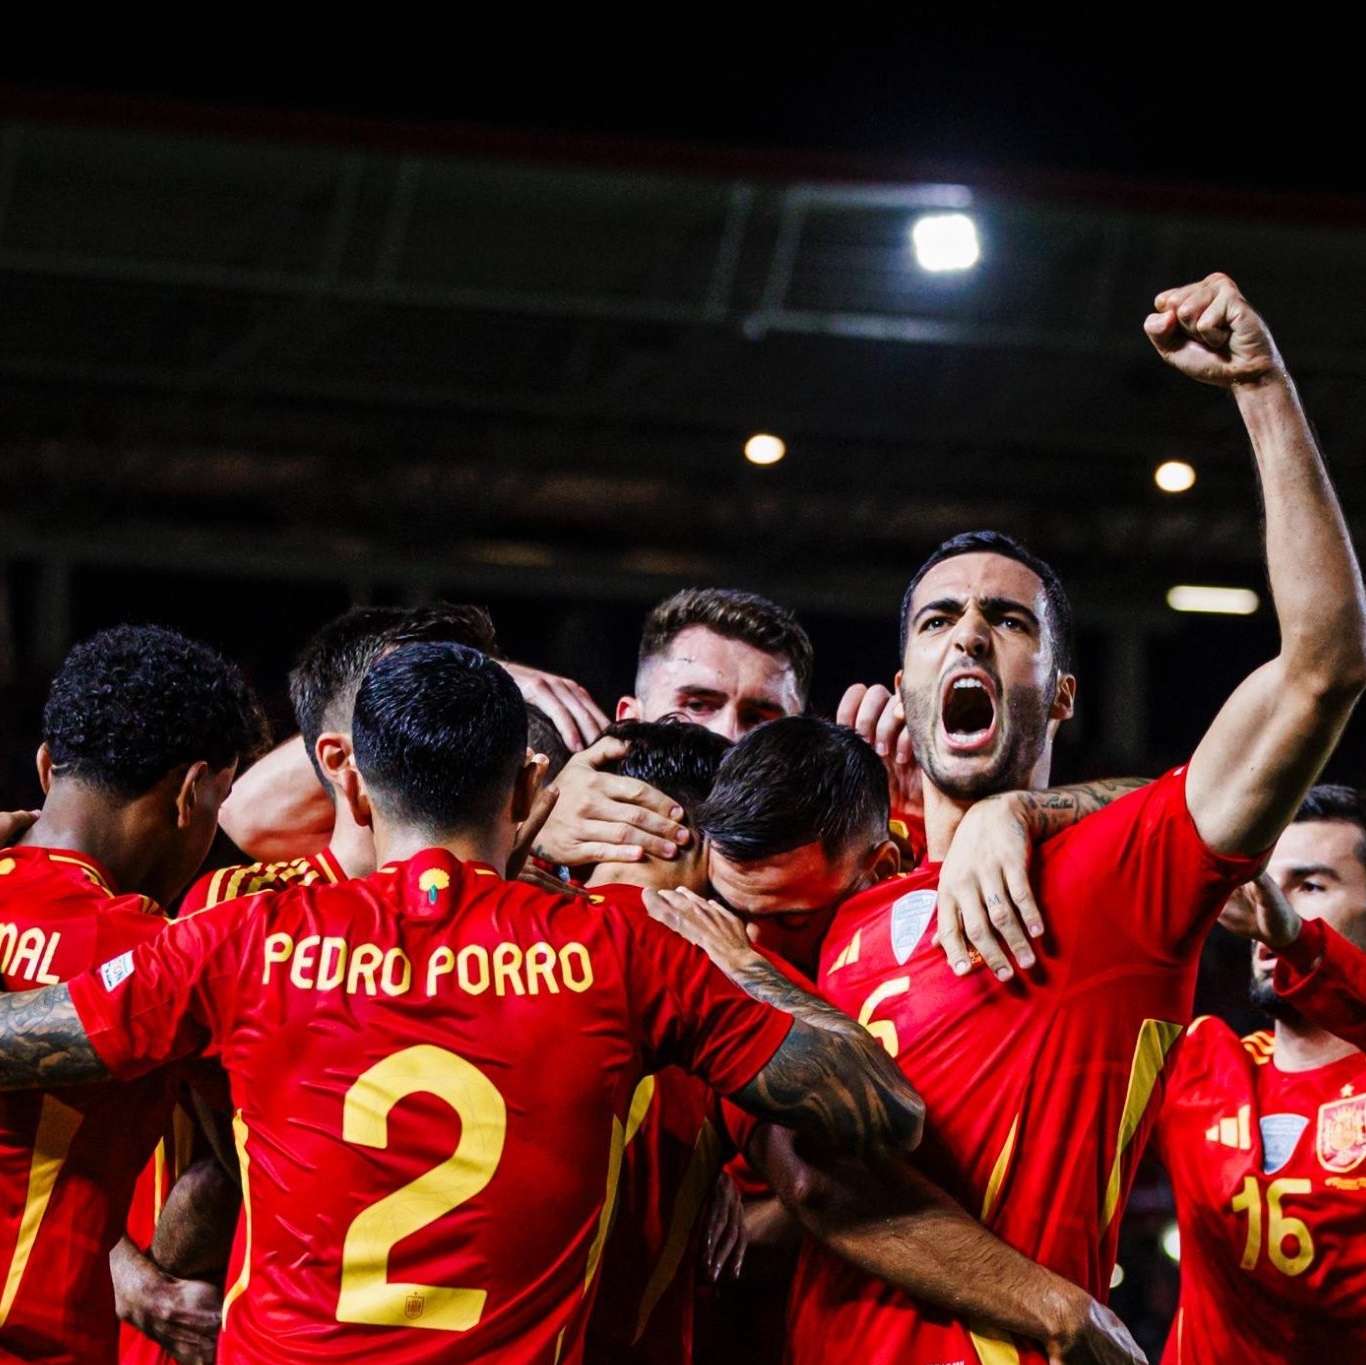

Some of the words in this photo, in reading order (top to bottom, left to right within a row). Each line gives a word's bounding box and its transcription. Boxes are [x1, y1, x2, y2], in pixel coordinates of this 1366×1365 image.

[262, 932, 411, 997] PEDRO
[427, 941, 594, 997] PORRO
[336, 1045, 507, 1332] 2
[1232, 1176, 1315, 1276] 16
